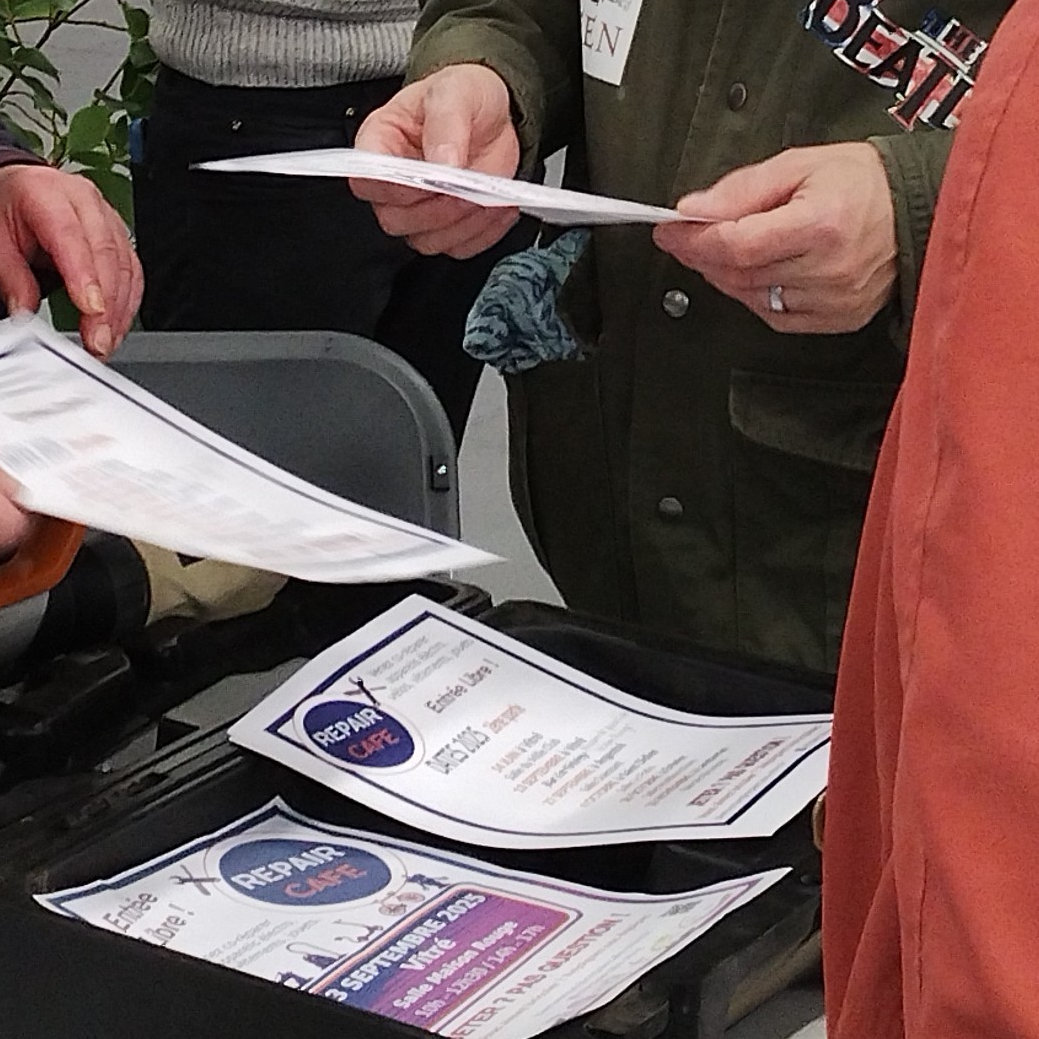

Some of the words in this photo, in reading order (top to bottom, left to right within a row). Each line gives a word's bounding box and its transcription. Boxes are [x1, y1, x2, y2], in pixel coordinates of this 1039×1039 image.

[313, 707, 384, 748] REPAIR
[347, 727, 400, 760] CAFE
[230, 844, 346, 891] REPAIR
[282, 862, 368, 899] CAFE
[340, 917, 447, 992] SEPTEMBRE
[436, 892, 487, 923] 2025
[399, 936, 457, 971] Vitré
[393, 983, 434, 1010] Salle
[470, 920, 519, 951] Rouge
[451, 1006, 499, 1039] ETER
[537, 918, 624, 973] QUESTION
